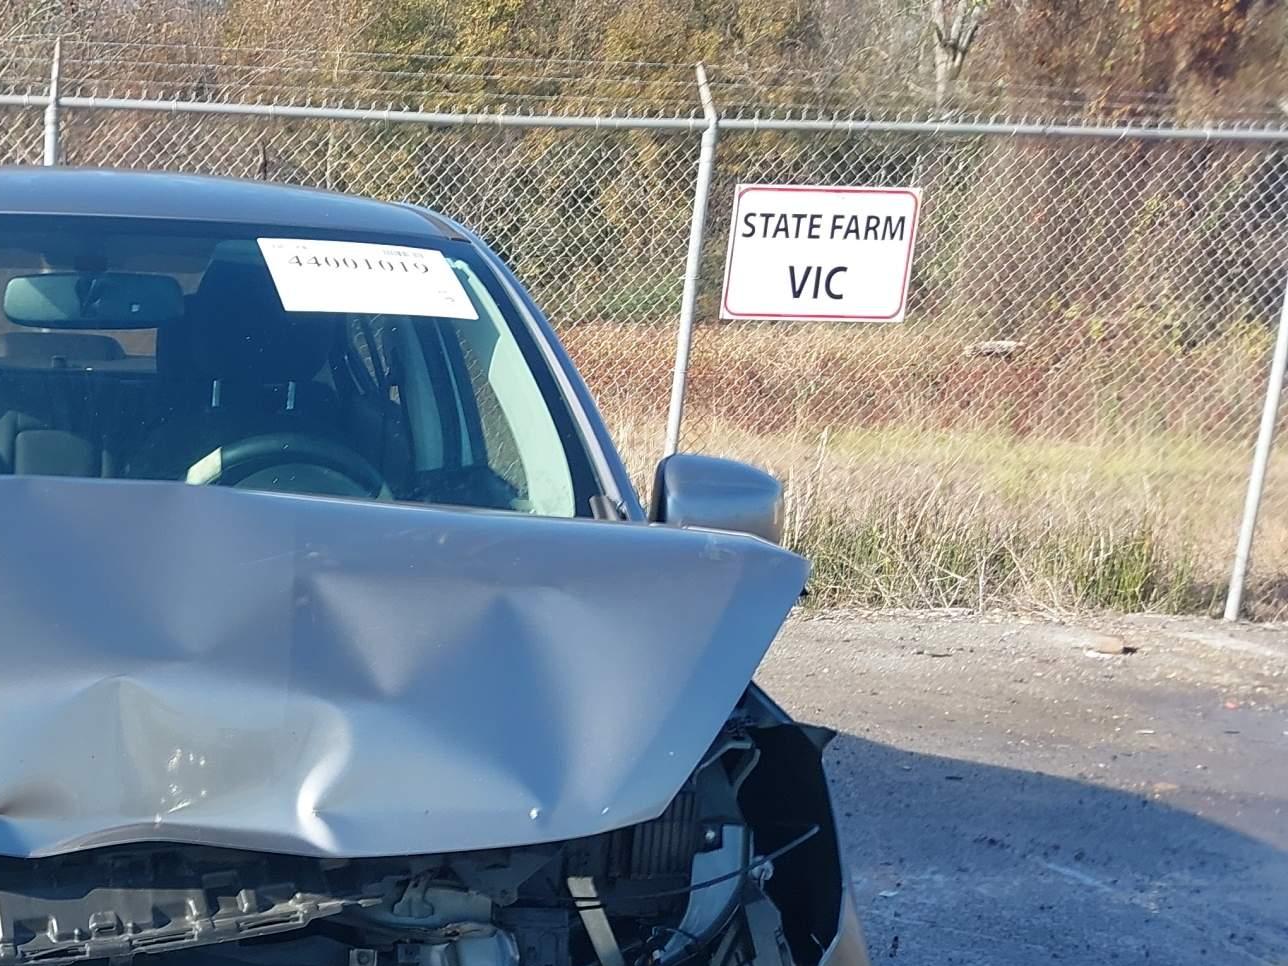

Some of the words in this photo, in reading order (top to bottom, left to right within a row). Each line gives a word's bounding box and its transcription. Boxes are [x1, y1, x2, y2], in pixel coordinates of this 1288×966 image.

[741, 212, 823, 240] STATE
[829, 214, 906, 241] FARM
[287, 254, 430, 274] 44001019
[788, 265, 849, 300] VIC
